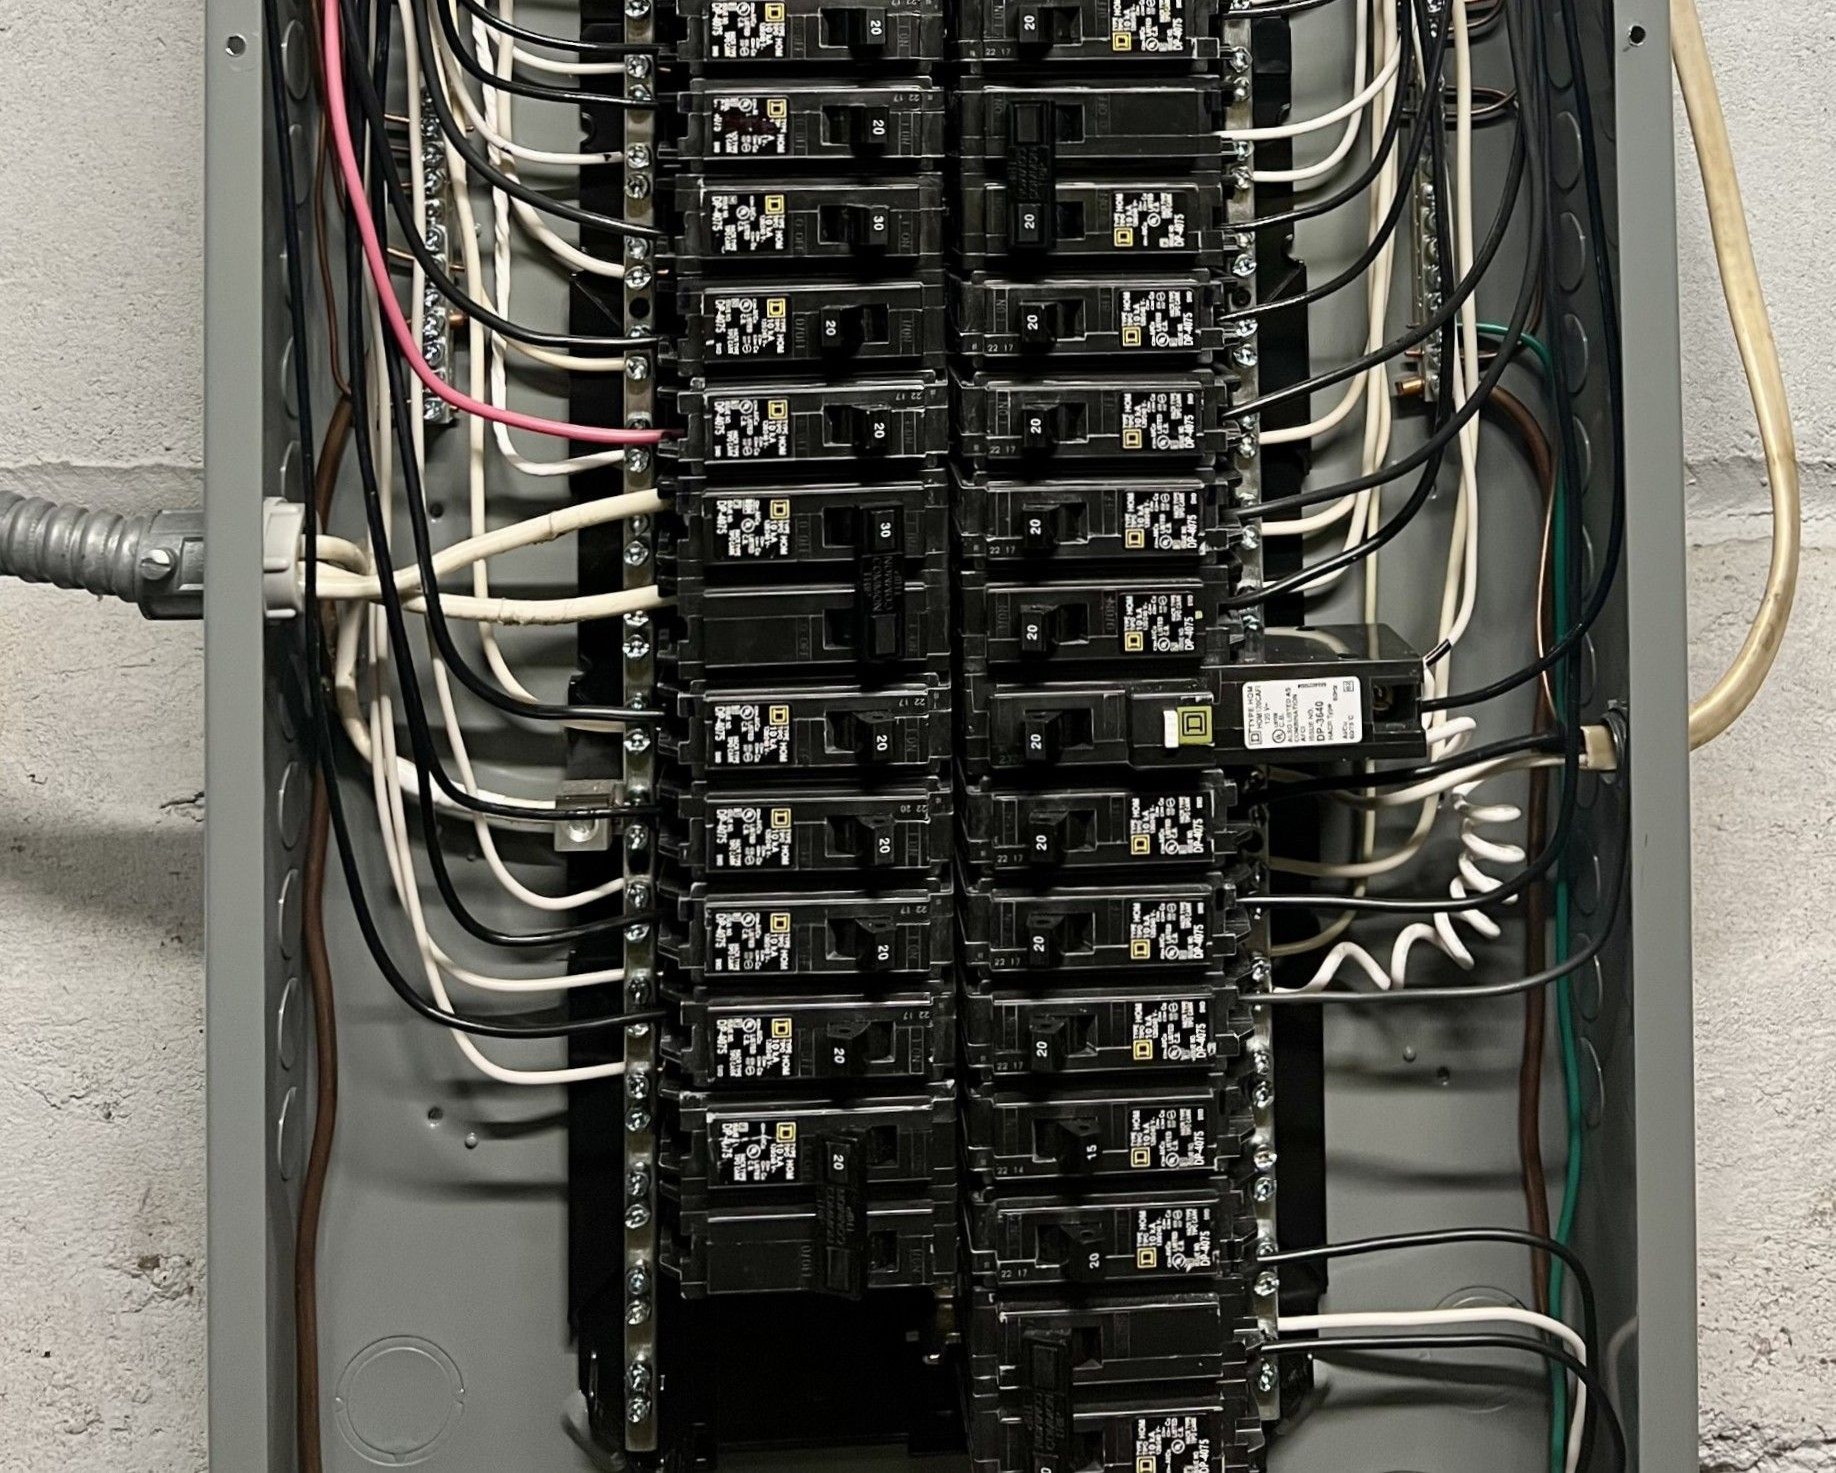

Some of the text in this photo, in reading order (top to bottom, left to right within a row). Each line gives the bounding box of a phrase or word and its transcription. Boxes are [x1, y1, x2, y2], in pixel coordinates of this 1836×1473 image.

[870, 20, 883, 35] 20
[1023, 15, 1036, 30] 20
[872, 119, 885, 135] 20
[873, 215, 884, 231] 30
[1024, 214, 1035, 229] 20
[825, 320, 837, 336] 20
[1027, 314, 1038, 330] 20
[987, 343, 998, 353] 22
[874, 422, 885, 439] 20
[1030, 418, 1042, 434] 20
[880, 522, 891, 538] 30
[1029, 519, 1041, 535] 20
[1026, 624, 1038, 640] 20
[1285, 687, 1291, 696] AS
[876, 734, 888, 751] 20
[1030, 734, 1042, 750] 20
[879, 837, 891, 854] 20
[1036, 835, 1047, 851] 20
[1033, 936, 1045, 952] 20
[877, 944, 889, 961] 20
[834, 1047, 845, 1064] 20
[1036, 1041, 1048, 1057] 20
[1086, 1144, 1097, 1160] 15
[833, 1154, 844, 1170] 20
[1089, 1253, 1100, 1269] 20
